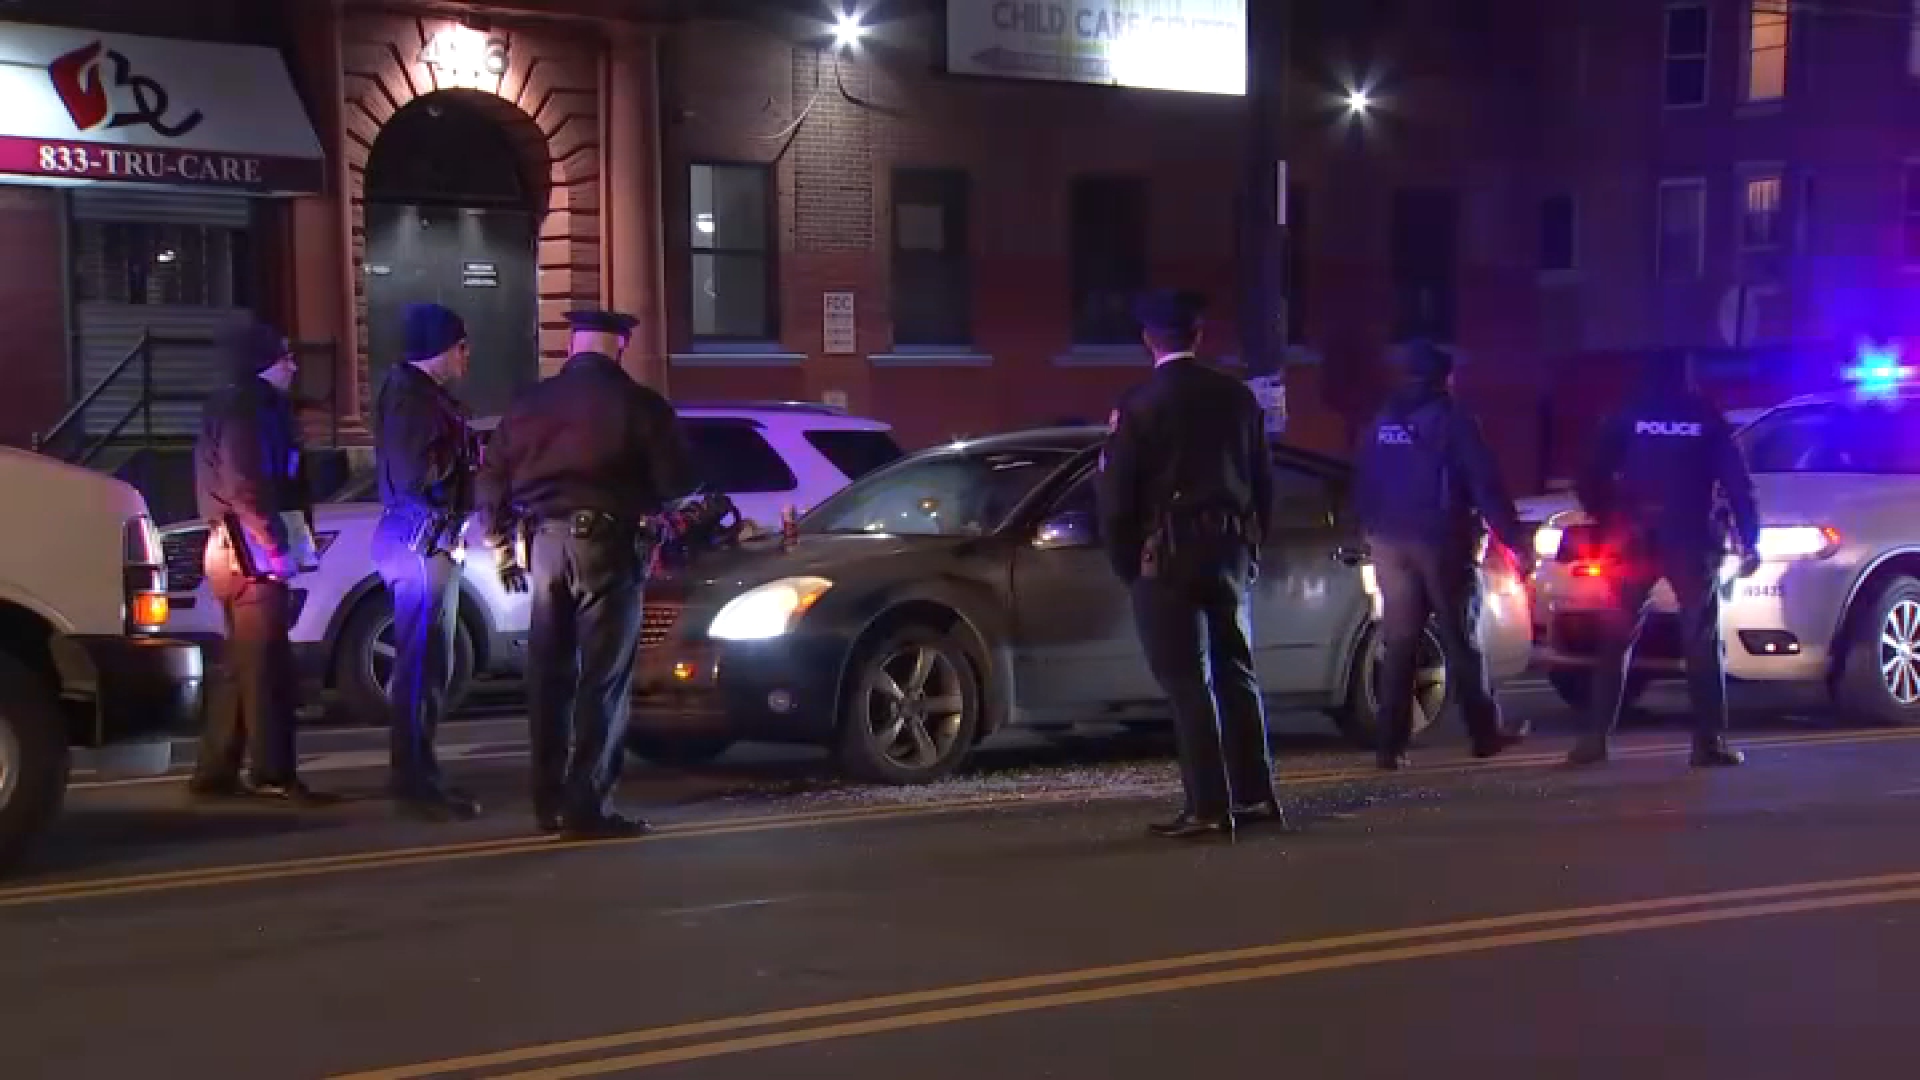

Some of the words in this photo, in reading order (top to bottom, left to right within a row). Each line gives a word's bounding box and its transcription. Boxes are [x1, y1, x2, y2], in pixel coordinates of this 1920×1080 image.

[991, 2, 1066, 34] CHILD
[38, 144, 263, 183] 833-TRU-CARE
[1635, 420, 1702, 437] POLICE
